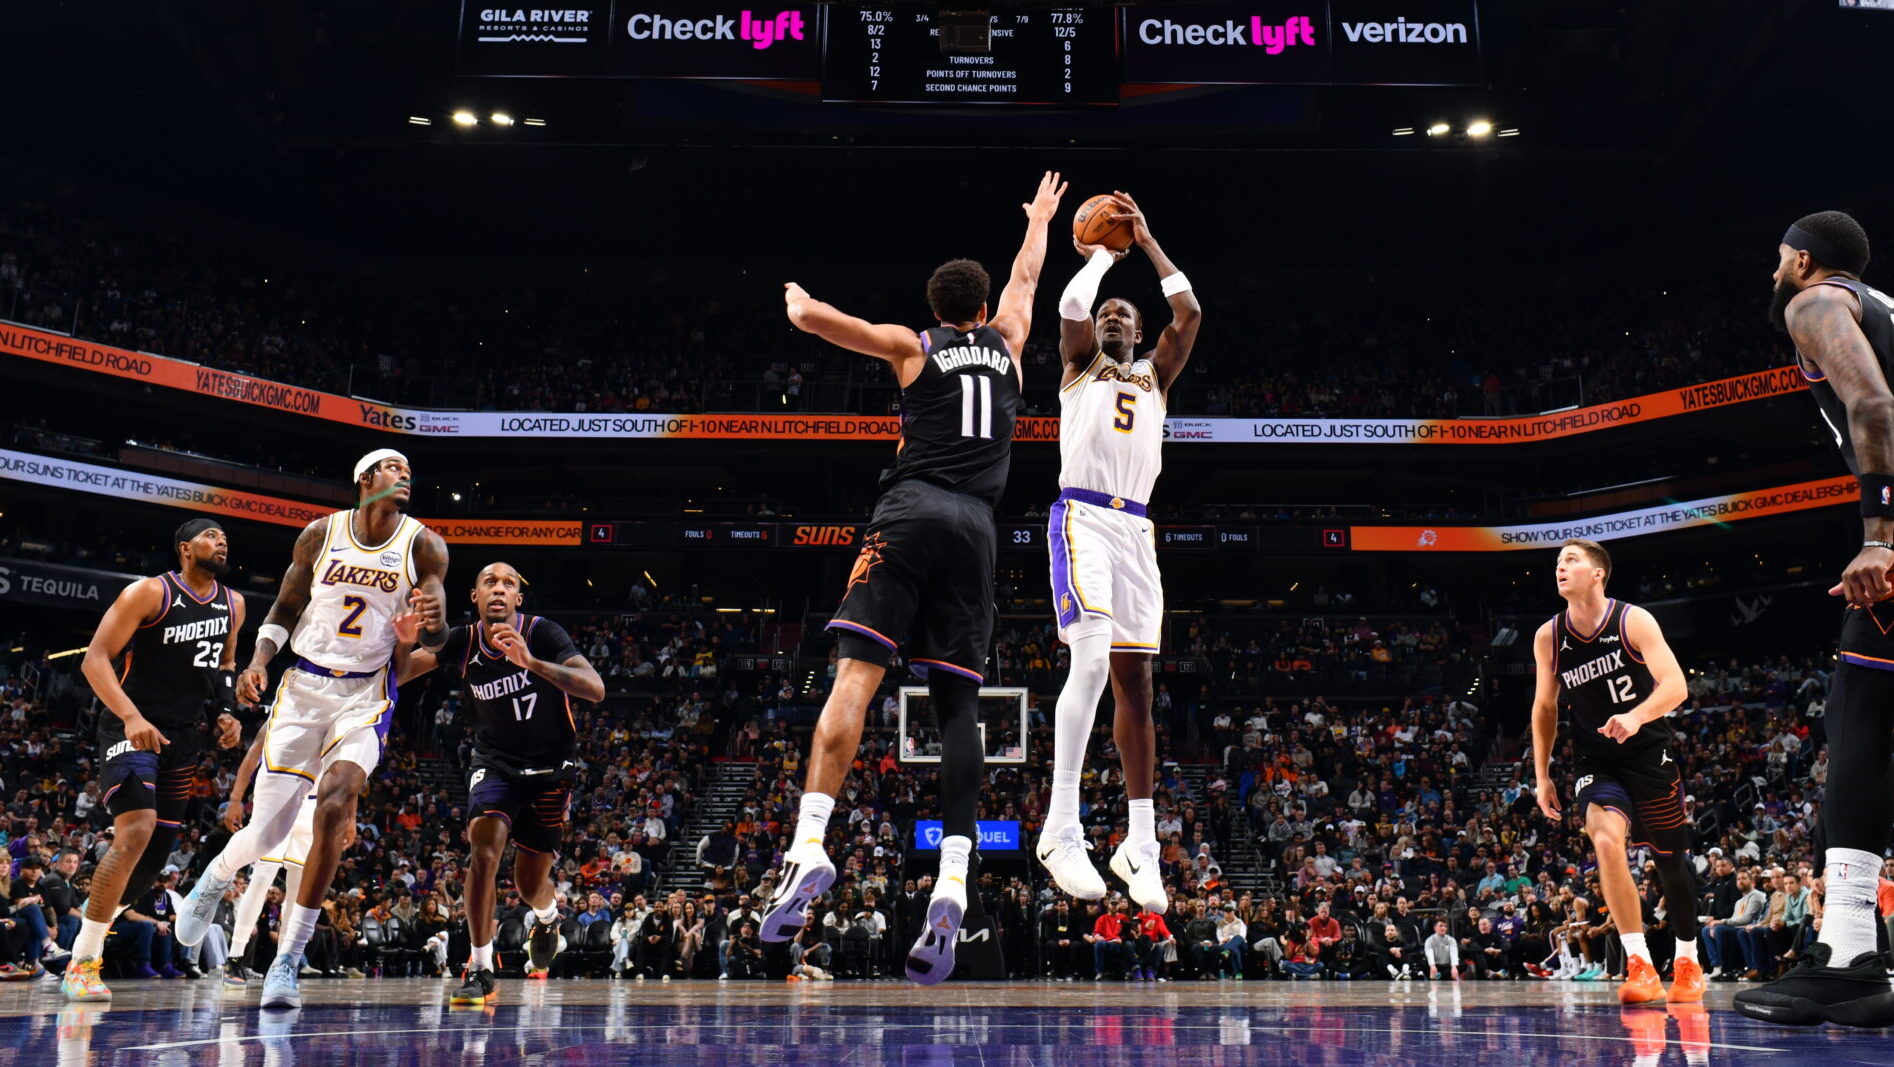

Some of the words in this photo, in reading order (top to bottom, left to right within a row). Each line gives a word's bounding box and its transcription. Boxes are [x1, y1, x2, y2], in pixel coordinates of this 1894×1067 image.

[480, 9, 526, 22] GILA
[529, 9, 589, 23] RIVER
[860, 11, 893, 22] 75.0%
[916, 14, 929, 22] 3/4
[1016, 15, 1029, 23] 7/9
[1051, 13, 1083, 24] 77.8%
[627, 14, 735, 40] Check
[740, 10, 805, 50] lyft
[867, 24, 885, 35] 8/2
[1054, 27, 1076, 37] 12/5
[1138, 18, 1246, 45] Check
[1251, 15, 1316, 55] lyft
[1342, 17, 1467, 43] verizon
[871, 38, 881, 49] 13
[1064, 41, 1071, 51] 6
[872, 52, 879, 62] 2
[949, 56, 994, 64] TURNOVERS
[1064, 54, 1071, 65] 8
[870, 66, 880, 77] 12
[926, 70, 953, 78] POINTS
[956, 70, 969, 78] OFF
[972, 70, 1016, 78] TURNOVERS
[1064, 68, 1071, 79] 2
[871, 80, 878, 91] 7
[925, 84, 955, 92] SECOND
[957, 84, 987, 92] CHANCE
[989, 84, 1017, 92] POINTS
[1064, 82, 1071, 93] 9
[10, 332, 104, 365] LITCHFIELD
[105, 354, 152, 376] ROAD
[932, 346, 1010, 375] IGHODARO
[196, 369, 321, 415] YATESBUICKGMC.COM
[361, 404, 416, 430] Yates
[959, 374, 993, 440] 11
[1113, 391, 1137, 434] 5
[418, 425, 460, 433] GMC
[501, 418, 570, 432] LOCATED
[571, 418, 611, 432] JUST
[612, 419, 665, 432] SOUTH
[668, 419, 688, 433] OF
[690, 419, 717, 433] I-10
[718, 420, 759, 433] NEAR
[761, 420, 772, 433] N
[774, 420, 857, 434] LITCHFIELD
[859, 421, 900, 434] ROAD
[1254, 423, 1322, 437] LOCATED
[1324, 424, 1362, 438] JUST
[1364, 424, 1415, 438] SOUTH
[1417, 424, 1439, 438] OF
[1440, 425, 1466, 439] I-10
[1467, 425, 1508, 439] NEAR
[1511, 425, 1521, 437] N
[1523, 411, 1600, 437] LITCHFIELD
[1601, 403, 1641, 423] ROAD
[0, 457, 27, 472] OUR
[27, 461, 64, 479] SUNS
[66, 468, 111, 487] TICKET
[111, 476, 128, 490] AT
[129, 479, 154, 495] THE
[155, 484, 192, 501] YATES
[193, 490, 229, 508] BUICK
[229, 497, 259, 513] GMC
[1501, 530, 1539, 544] SHOW
[1540, 528, 1573, 541] YOUR
[1573, 523, 1604, 538] SUNS
[1604, 516, 1643, 533] TICKET
[1643, 514, 1658, 527] AT
[1658, 510, 1682, 524] THE
[1682, 504, 1718, 520] YATES
[1718, 499, 1754, 515] BUICK
[1754, 494, 1784, 510] GMC
[1784, 481, 1860, 505] DEALERSHIP
[434, 525, 452, 537] OIL
[453, 526, 505, 538] CHANGE
[505, 526, 529, 538] FOR
[529, 526, 556, 538] ANY
[556, 527, 582, 538] CAR
[598, 528, 605, 538] 4
[731, 530, 760, 539] TIMEOUTS
[793, 526, 856, 545] SUNS
[1013, 531, 1031, 543] 33
[1166, 533, 1171, 542] 6
[1173, 533, 1203, 541] TIMEOUTS
[1330, 534, 1337, 543] 4
[20, 575, 99, 600] TEQUILA
[320, 558, 400, 593] LAKERS
[338, 595, 367, 639] 2
[163, 616, 229, 645] PHOENIX
[1600, 635, 1619, 644] PayPal
[193, 640, 224, 668] 23
[1561, 649, 1625, 690] PHOENIX
[1607, 674, 1637, 704] 12
[512, 692, 538, 722] 17
